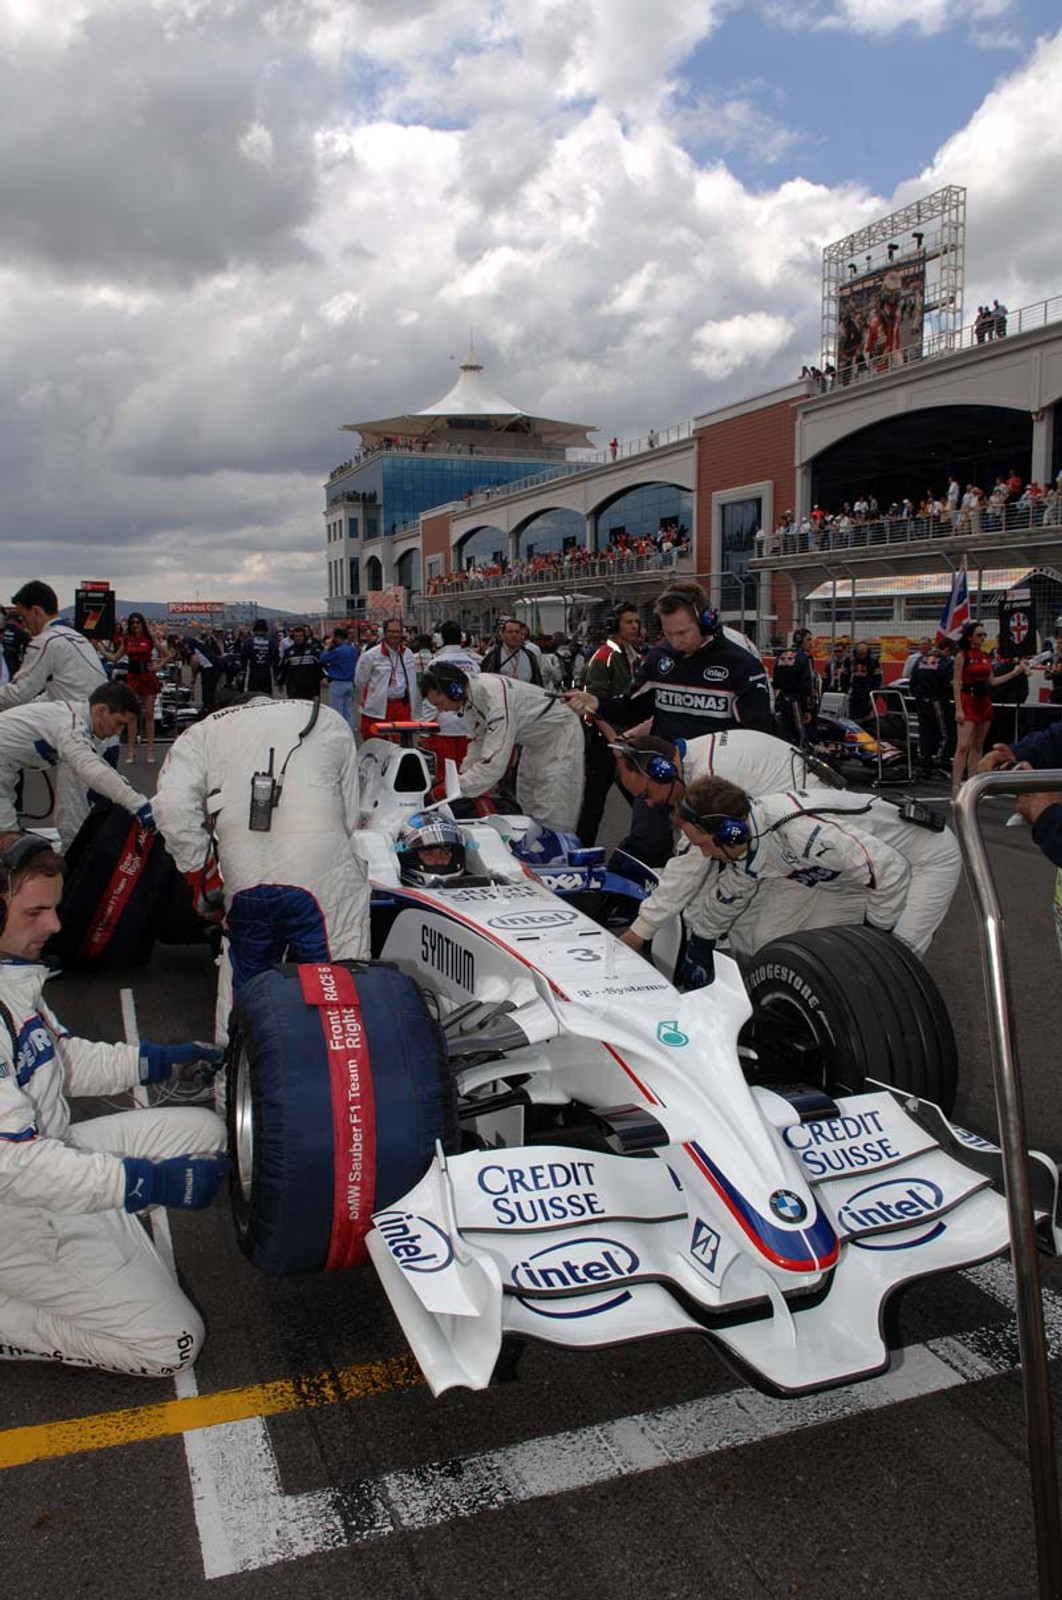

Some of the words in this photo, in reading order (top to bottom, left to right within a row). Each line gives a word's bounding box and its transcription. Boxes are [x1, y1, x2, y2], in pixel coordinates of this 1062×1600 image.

[83, 603, 106, 630] 7
[497, 912, 567, 926] intel
[421, 924, 474, 995] SYNTIUM
[566, 948, 602, 962] 3
[319, 973, 339, 1001] RACE
[327, 1010, 345, 1050] Front
[341, 1008, 361, 1049] Right
[347, 1059, 361, 1101] Team
[350, 1105, 363, 1124] F1
[781, 1110, 884, 1151] CREDIT
[349, 1126, 363, 1182] Sauber
[801, 1138, 900, 1175] SUISSE
[477, 1162, 595, 1195] CREDIT
[492, 1193, 605, 1225] SUISSE
[841, 1188, 936, 1227] intel
[378, 1214, 438, 1264] intel
[520, 1251, 626, 1288] intel
